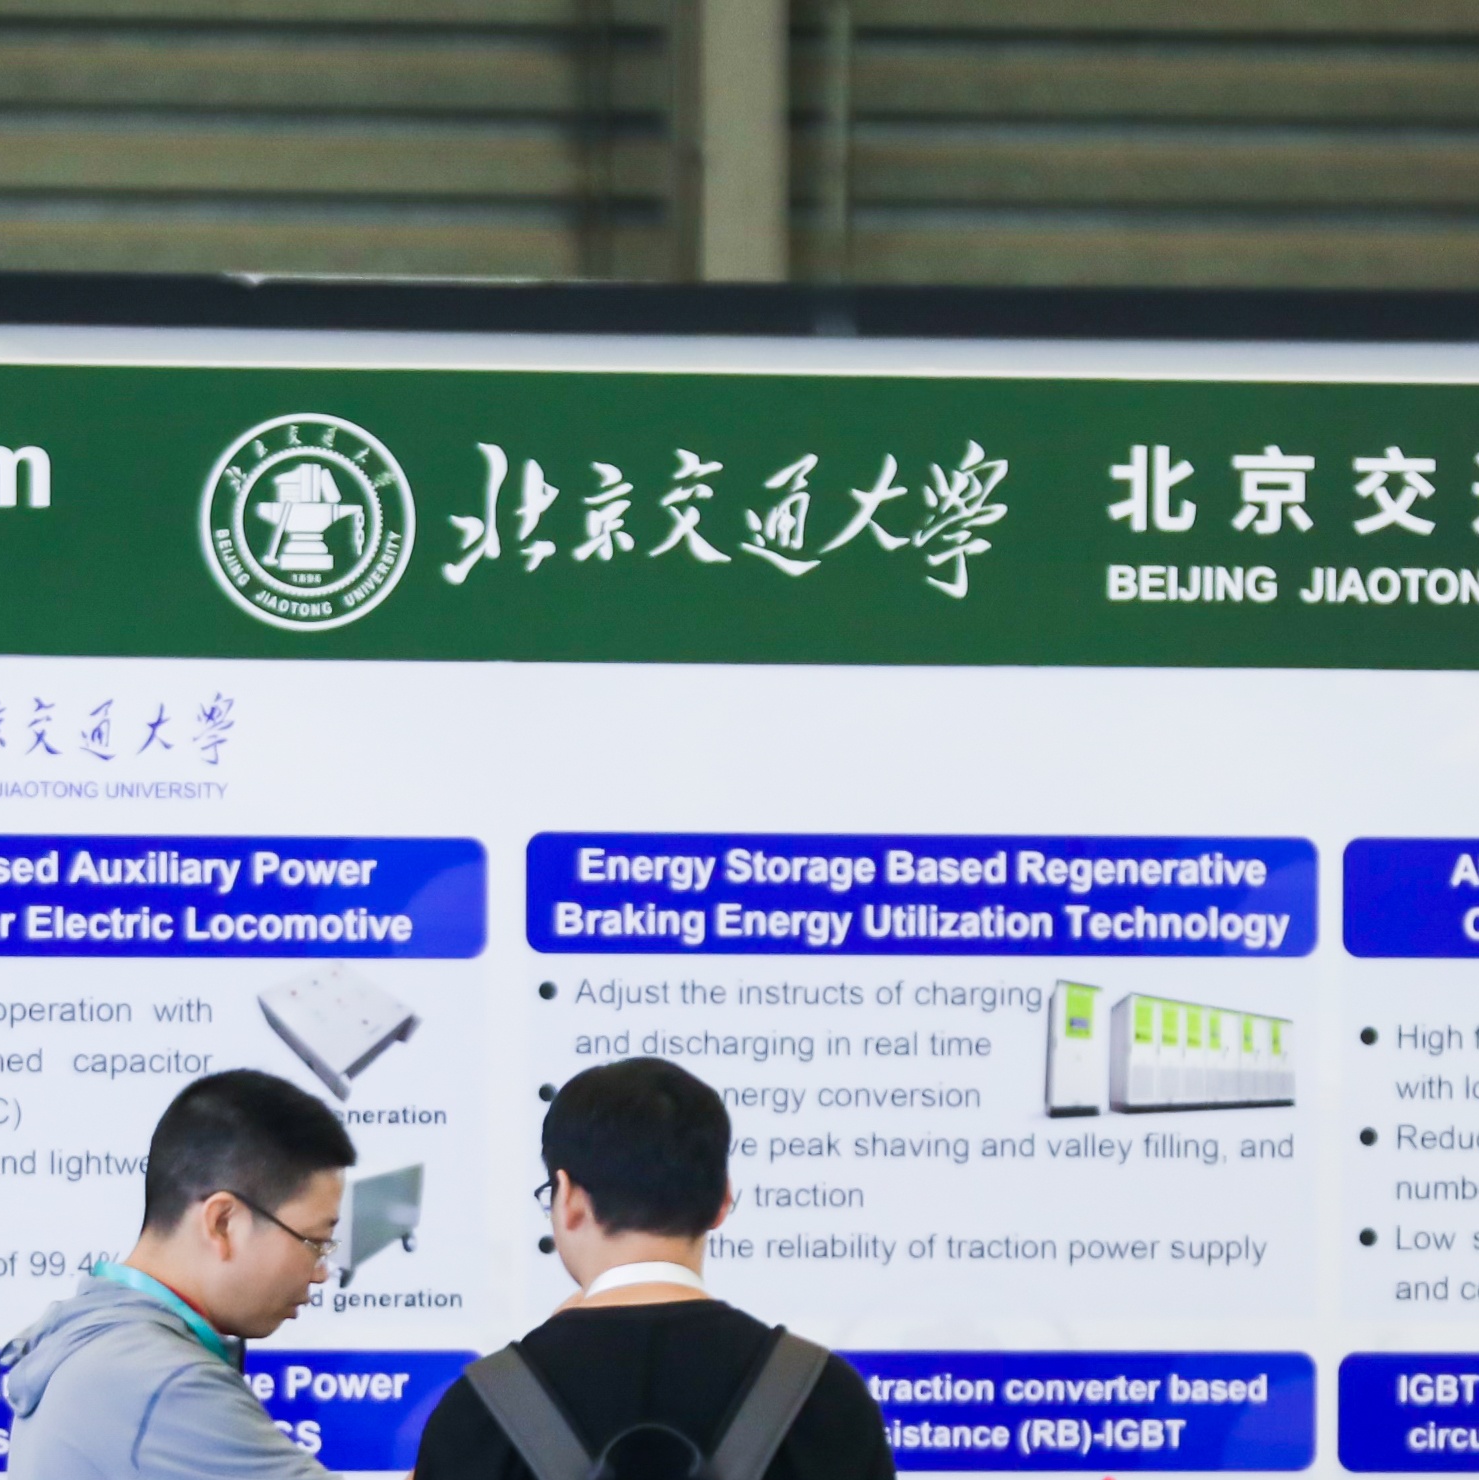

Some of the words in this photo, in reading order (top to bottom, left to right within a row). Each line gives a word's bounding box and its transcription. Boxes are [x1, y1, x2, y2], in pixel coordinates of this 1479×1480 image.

[215, 527, 251, 588] BEIJING
[254, 590, 333, 617] JIAOTONG
[343, 529, 404, 608] UNIVERSITY
[1107, 565, 1279, 604] BEIJING
[106, 782, 228, 800] UNIVERSITY
[69, 851, 243, 894] Auxiliary
[253, 852, 379, 888] Power
[579, 848, 717, 892] Energy
[727, 849, 877, 893] Storage
[887, 850, 1008, 886] Based
[1017, 851, 1268, 894] Regenerative
[26, 906, 175, 942] Electric
[185, 907, 415, 944] Locomotive
[555, 902, 707, 947] Braking
[716, 903, 854, 947] Energy
[864, 905, 1054, 940] Utilization
[1065, 905, 1292, 951] Technology
[153, 998, 214, 1024] with
[575, 979, 670, 1013] Adjust
[680, 980, 728, 1006] the
[739, 982, 865, 1007] instructs
[876, 981, 905, 1007] of
[915, 982, 1044, 1015] charging
[576, 1031, 631, 1058] and
[641, 1030, 817, 1064] discharging
[827, 1032, 853, 1058] in
[863, 1032, 921, 1058] real
[930, 1033, 994, 1059] time
[1398, 1025, 1464, 1058] High
[73, 1050, 215, 1078] capacitor
[817, 1087, 983, 1110] conversion
[1397, 1077, 1455, 1102] with
[770, 1133, 842, 1165] peak
[855, 1133, 971, 1166] shaving
[981, 1133, 1036, 1159] and
[1048, 1134, 1134, 1166] valley
[1144, 1133, 1228, 1167] filling,
[1240, 1135, 1295, 1160] and
[754, 1183, 866, 1210] traction
[708, 1233, 755, 1259] the
[767, 1235, 898, 1267] reliability
[909, 1234, 938, 1260] of
[947, 1237, 1058, 1261] traction
[1069, 1240, 1161, 1267] power
[1171, 1236, 1268, 1268] supply
[1395, 1226, 1458, 1253] Low
[332, 1287, 465, 1314] generation
[1396, 1276, 1451, 1303] and
[286, 1368, 410, 1401] Power
[868, 1372, 996, 1403] traction
[1004, 1375, 1160, 1405] converter
[1168, 1372, 1270, 1405] based
[1396, 1374, 1479, 1406] IGBT
[1017, 1418, 1187, 1457] (RB)-IGBT
